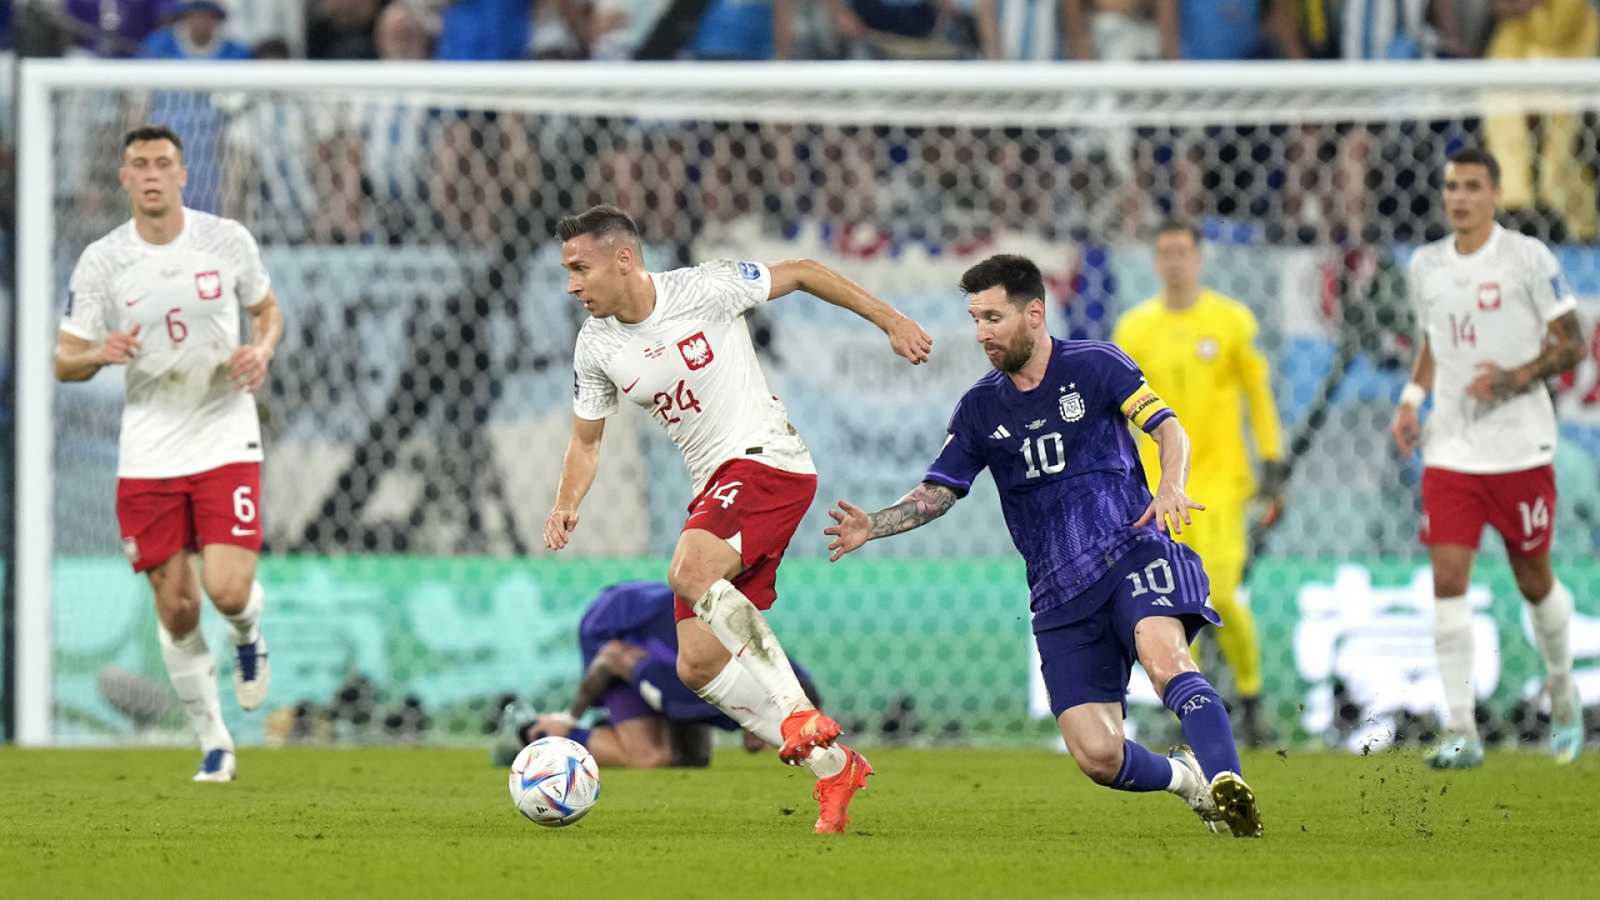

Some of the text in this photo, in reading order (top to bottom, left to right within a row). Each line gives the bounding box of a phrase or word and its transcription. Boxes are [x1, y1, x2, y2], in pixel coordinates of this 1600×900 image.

[165, 307, 188, 343] 6
[1449, 312, 1477, 348] 14
[653, 379, 702, 427] 24
[1018, 431, 1066, 479] 10
[233, 485, 256, 523] 6
[1518, 496, 1549, 537] 14
[1125, 557, 1175, 598] 10
